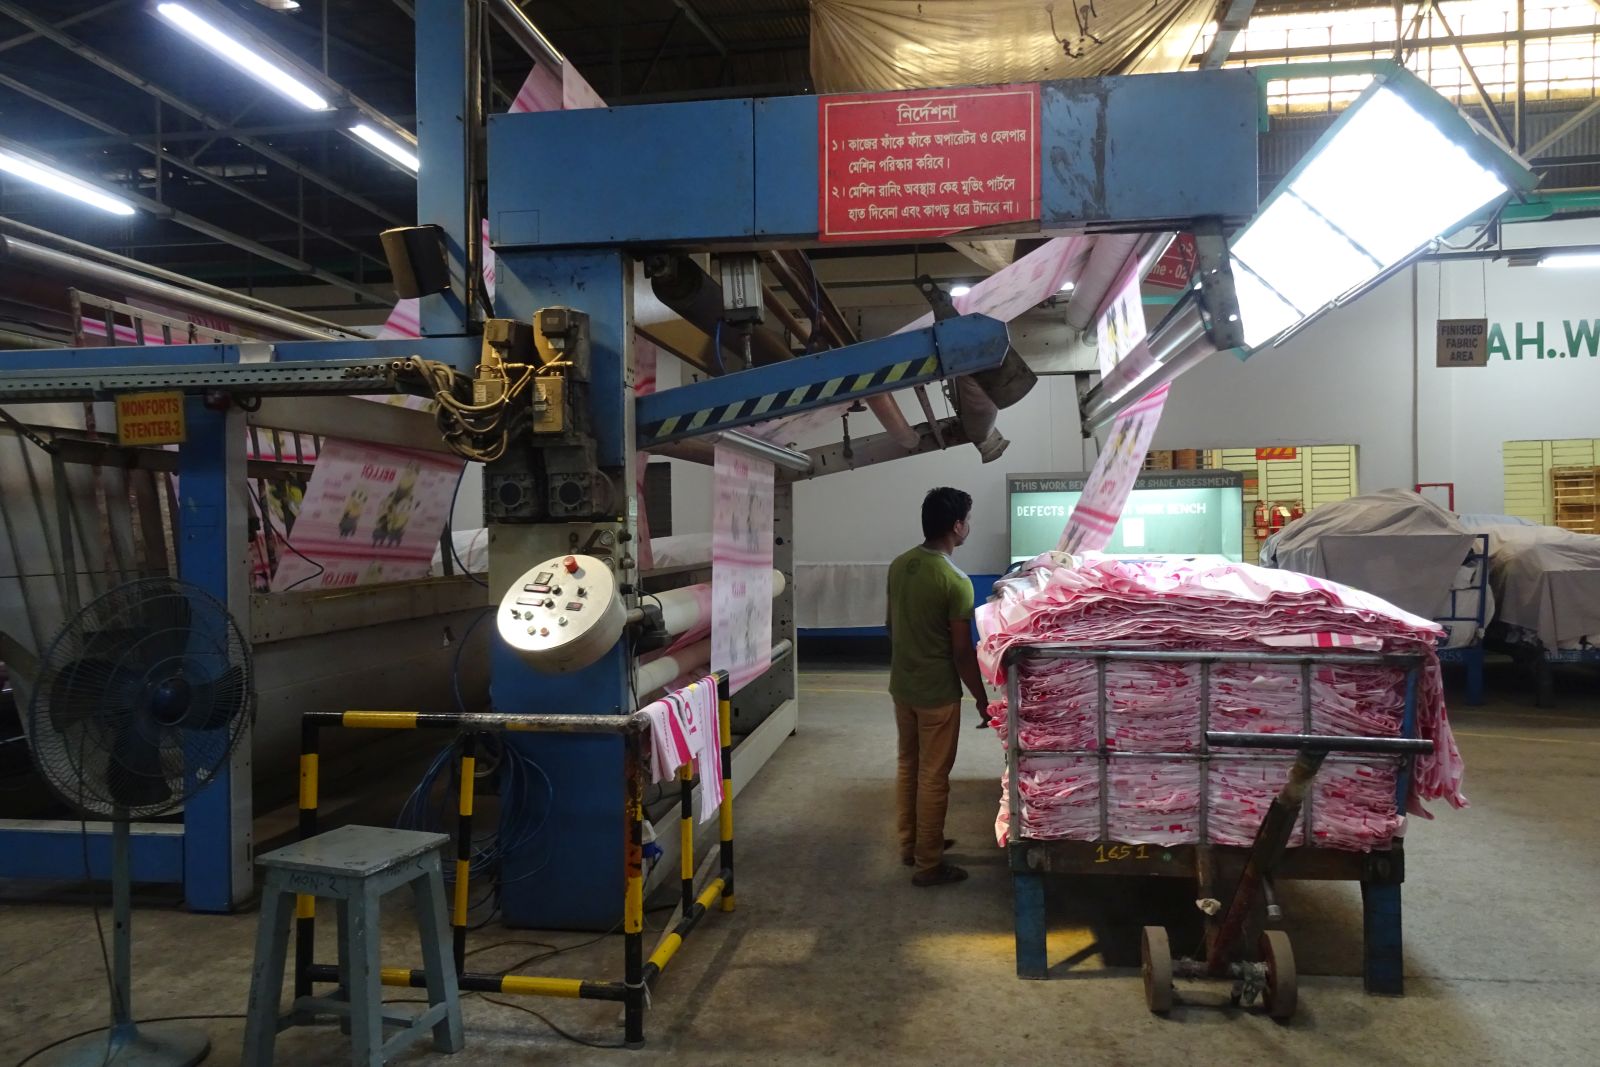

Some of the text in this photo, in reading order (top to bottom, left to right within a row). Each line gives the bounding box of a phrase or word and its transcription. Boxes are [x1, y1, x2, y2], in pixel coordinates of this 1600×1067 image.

[896, 101, 958, 123] নির্দেশনা
[848, 138, 878, 151] কাজের
[880, 133, 905, 149] ফাঁকে
[907, 132, 931, 147] ফাঁকে
[934, 129, 976, 146] অপারেটর
[980, 132, 988, 143] ও
[991, 129, 1027, 144] হেলপার
[848, 157, 876, 174] মেশিন
[848, 182, 876, 199] মেশিন
[879, 181, 902, 197] রানিং
[940, 181, 959, 194] কেহ
[848, 208, 866, 222] হাত
[869, 204, 898, 221] দিবেনা
[901, 206, 921, 219] এবং
[923, 204, 950, 219] কাপড়
[953, 203, 970, 216] ধরে
[1441, 325, 1483, 336] FINISHED
[1446, 338, 1478, 349] FABRIC
[1450, 352, 1474, 361] AREA
[121, 398, 180, 416] MONFORTS
[124, 420, 181, 439] STENTER-2
[1014, 477, 1237, 491] THIS WORK BEN OR SHADE ASSESSMENT
[1017, 505, 1065, 517] DEFECTS
[1167, 503, 1207, 515] BENCH
[1094, 844, 1150, 863] 1651
